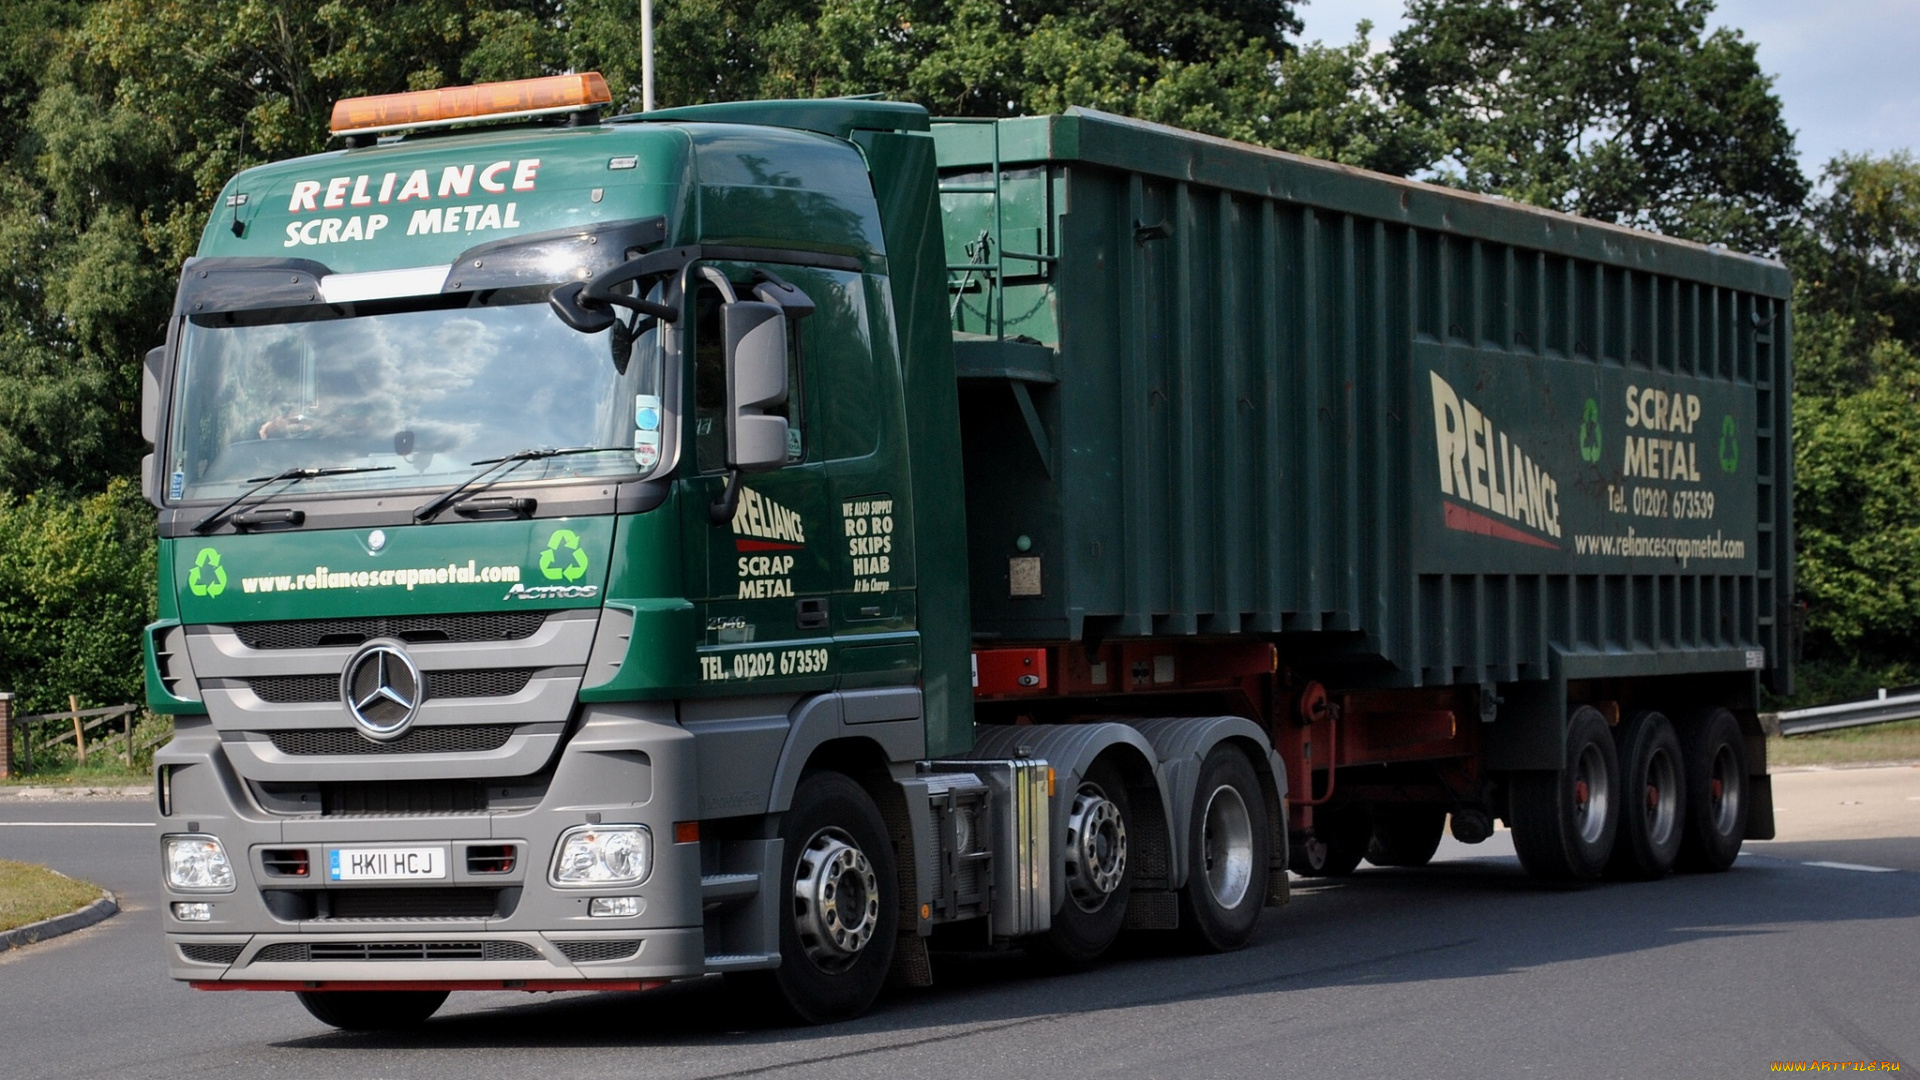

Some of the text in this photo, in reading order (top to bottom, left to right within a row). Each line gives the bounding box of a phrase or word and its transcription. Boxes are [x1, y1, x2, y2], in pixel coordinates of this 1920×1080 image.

[288, 158, 542, 214] RELIANCE
[283, 202, 521, 248] SCRAP METAL
[1625, 384, 1701, 434] SCRAP
[1429, 369, 1562, 539] RELIANCE
[1623, 436, 1701, 482] METAL
[722, 476, 805, 542] RELIANCE
[842, 500, 893, 517] WE ALSO SUPPLY
[1608, 484, 1715, 519] Tel. 01202 673539
[845, 515, 894, 537] RO RO
[849, 535, 892, 556] SKIPS
[1574, 526, 1745, 568] www.reliancescrapmetal.com
[242, 560, 521, 594] www.reliancescrapmetal.com
[738, 555, 794, 577] SCRAP
[853, 556, 890, 576] HIAB
[738, 578, 795, 600] METAL
[707, 616, 746, 631] 2546
[700, 648, 829, 681] TEL. 01202 673539
[393, 852, 432, 875] HCJ
